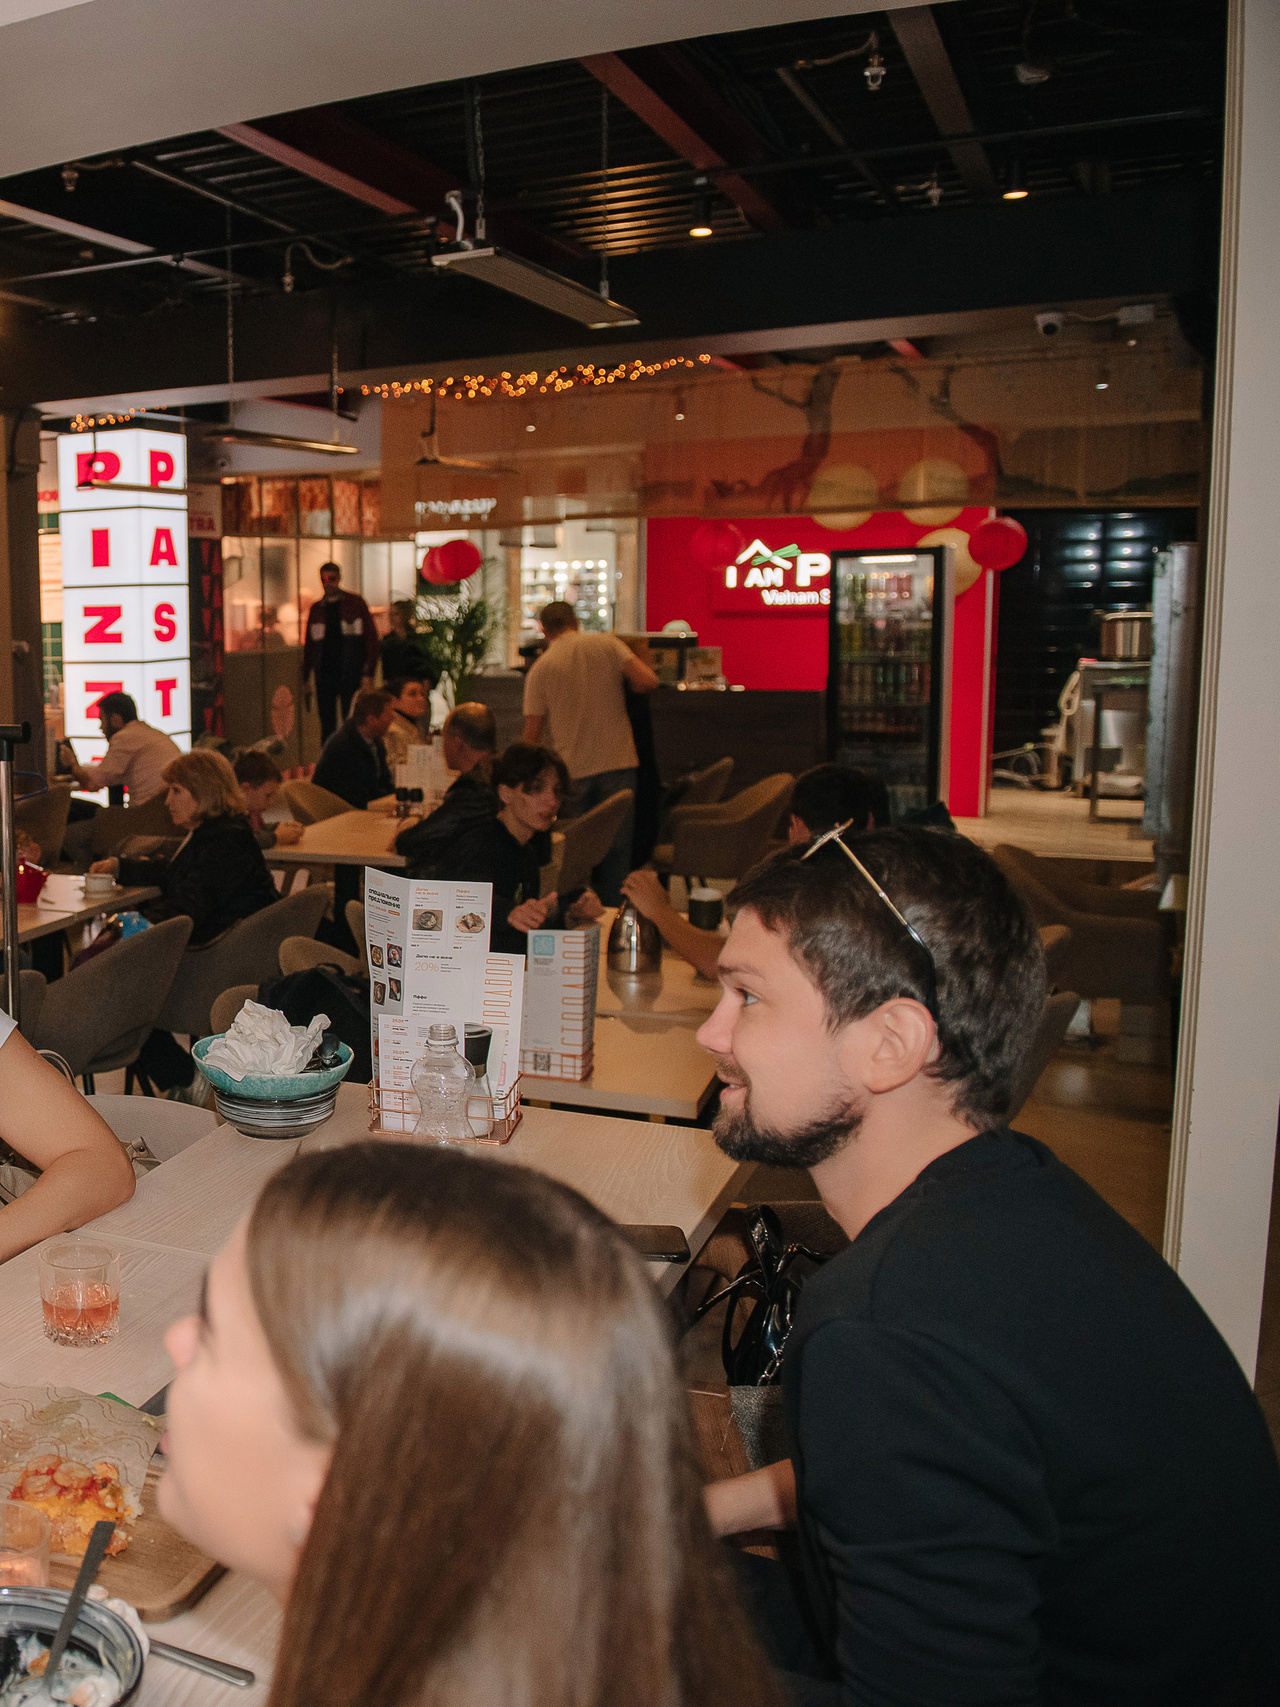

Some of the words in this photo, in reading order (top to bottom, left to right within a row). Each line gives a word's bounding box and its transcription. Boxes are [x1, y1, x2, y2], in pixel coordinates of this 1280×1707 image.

[725, 565, 737, 588] I
[744, 567, 784, 588] AM
[796, 553, 831, 587] P
[76, 450, 125, 766] PIZZ
[761, 589, 819, 605] Vietnam
[414, 961, 439, 972] 20%
